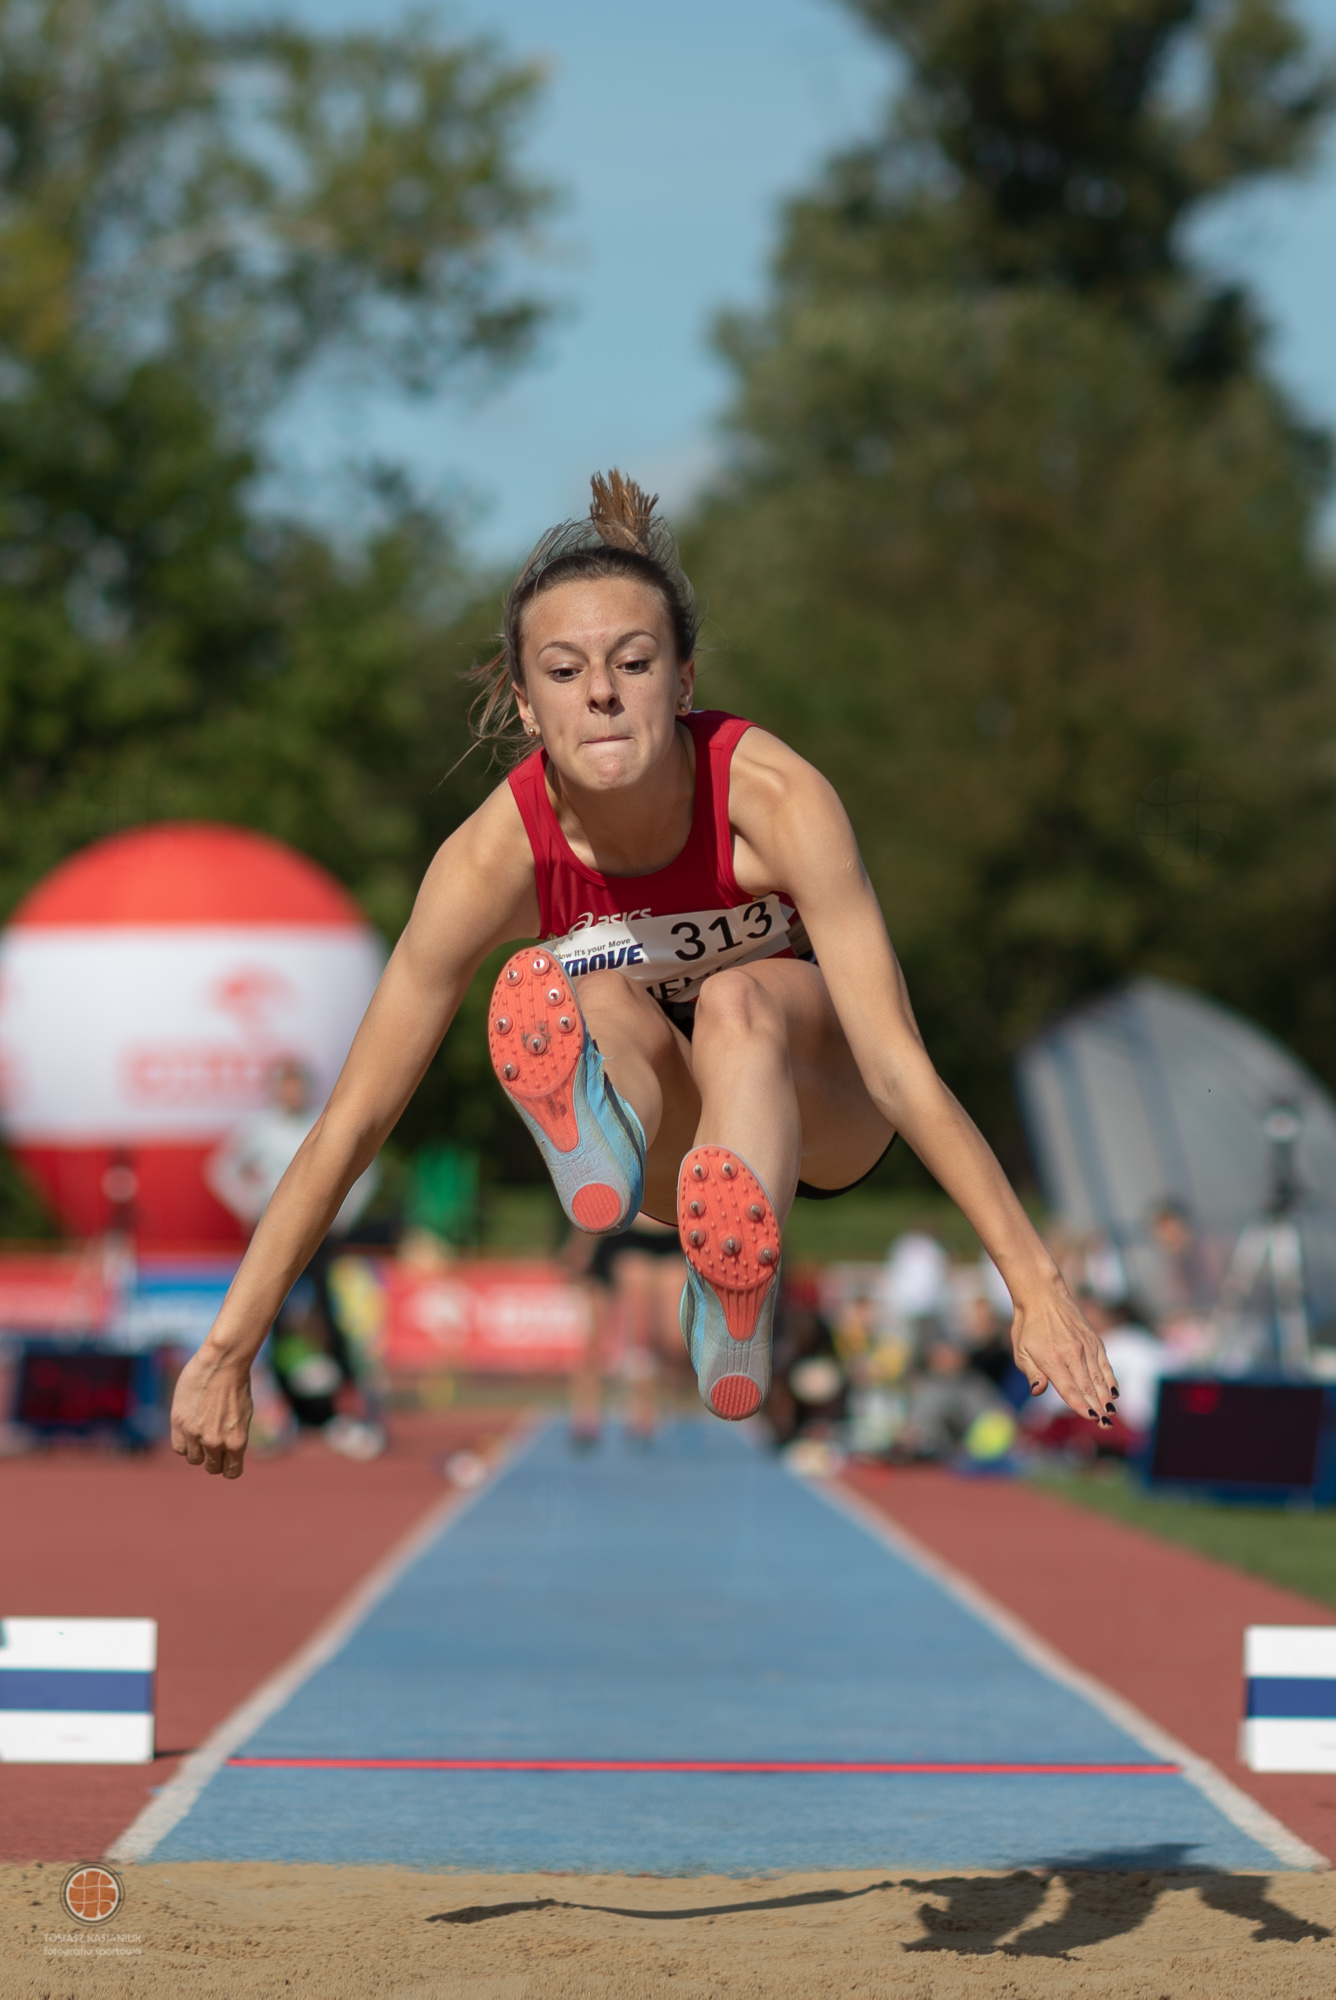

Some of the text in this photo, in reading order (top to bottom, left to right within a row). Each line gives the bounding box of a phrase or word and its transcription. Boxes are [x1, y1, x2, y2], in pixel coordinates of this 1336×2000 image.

[574, 949, 586, 957] It's
[588, 944, 606, 955] your
[609, 938, 631, 948] Move
[671, 902, 773, 961] 313
